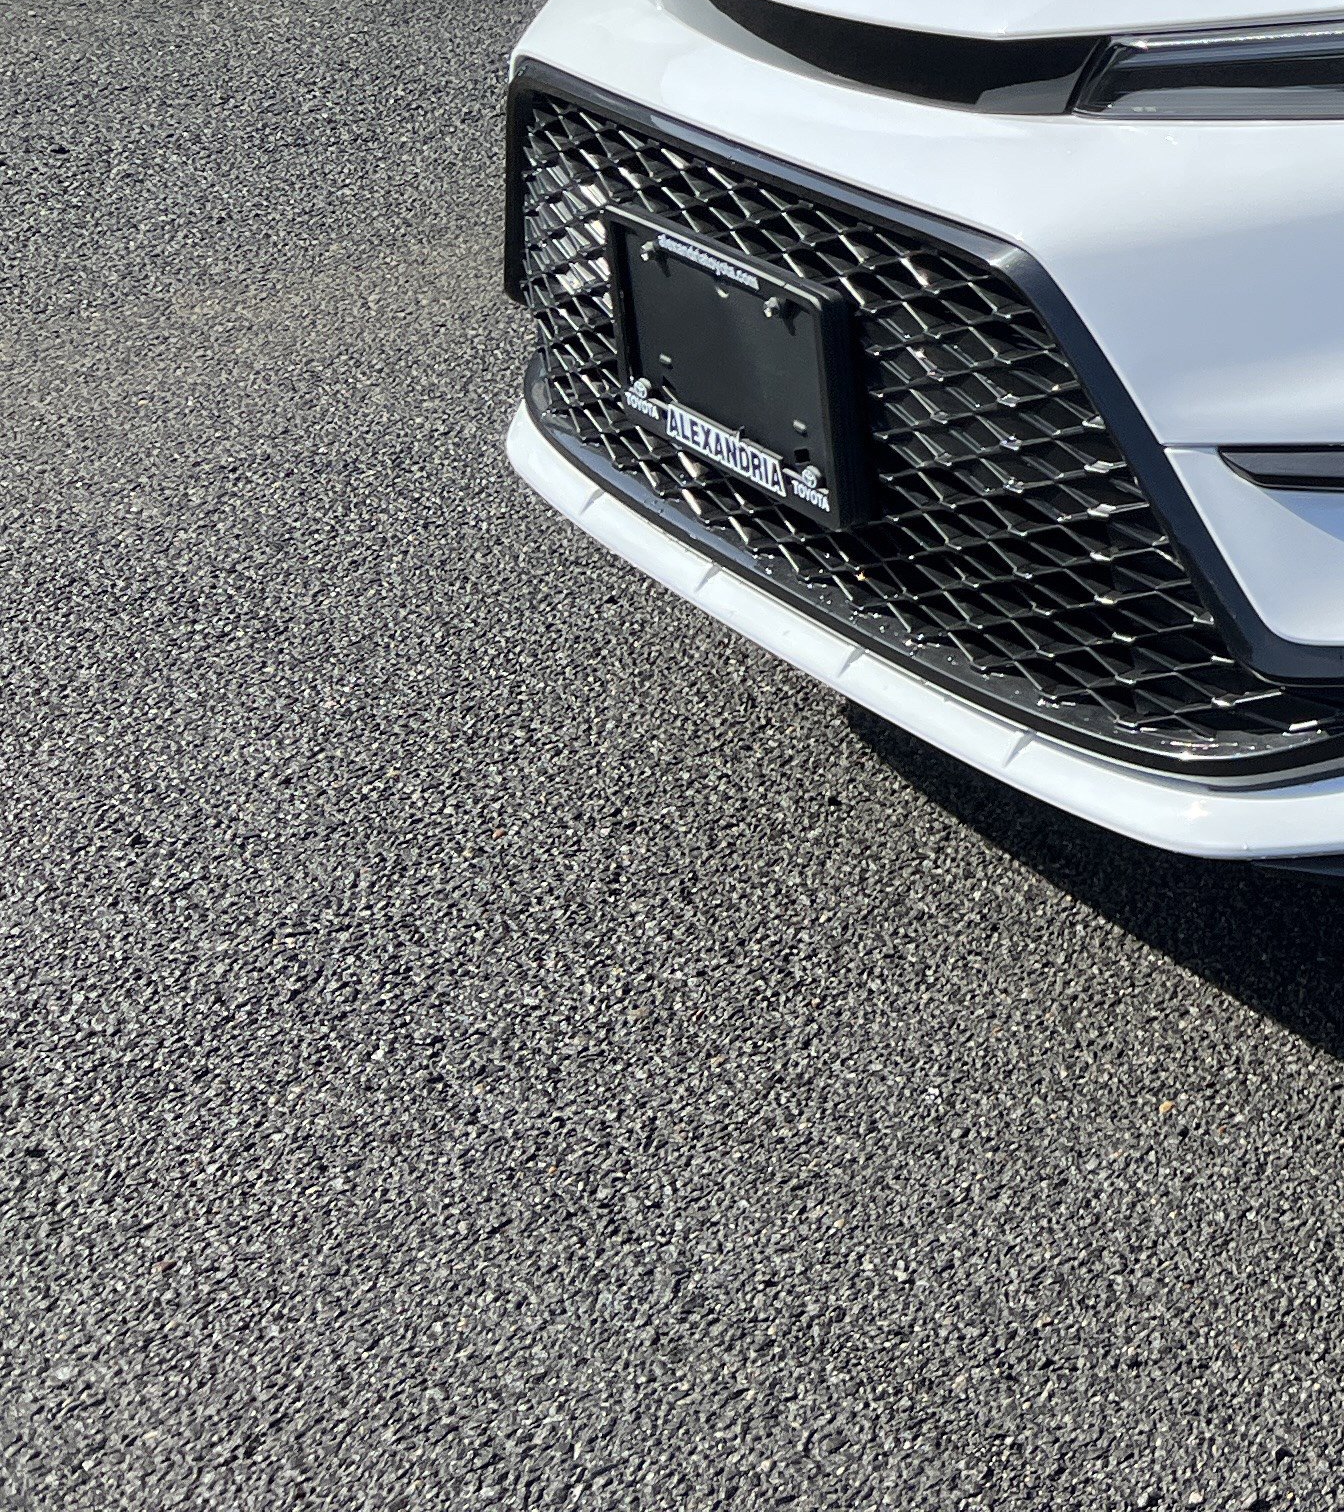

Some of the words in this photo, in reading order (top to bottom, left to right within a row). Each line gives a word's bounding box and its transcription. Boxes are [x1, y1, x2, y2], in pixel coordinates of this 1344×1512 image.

[624, 391, 660, 420] TOYOTA
[667, 408, 785, 494] ALEXANDRIA
[791, 480, 830, 512] TOYOTA
